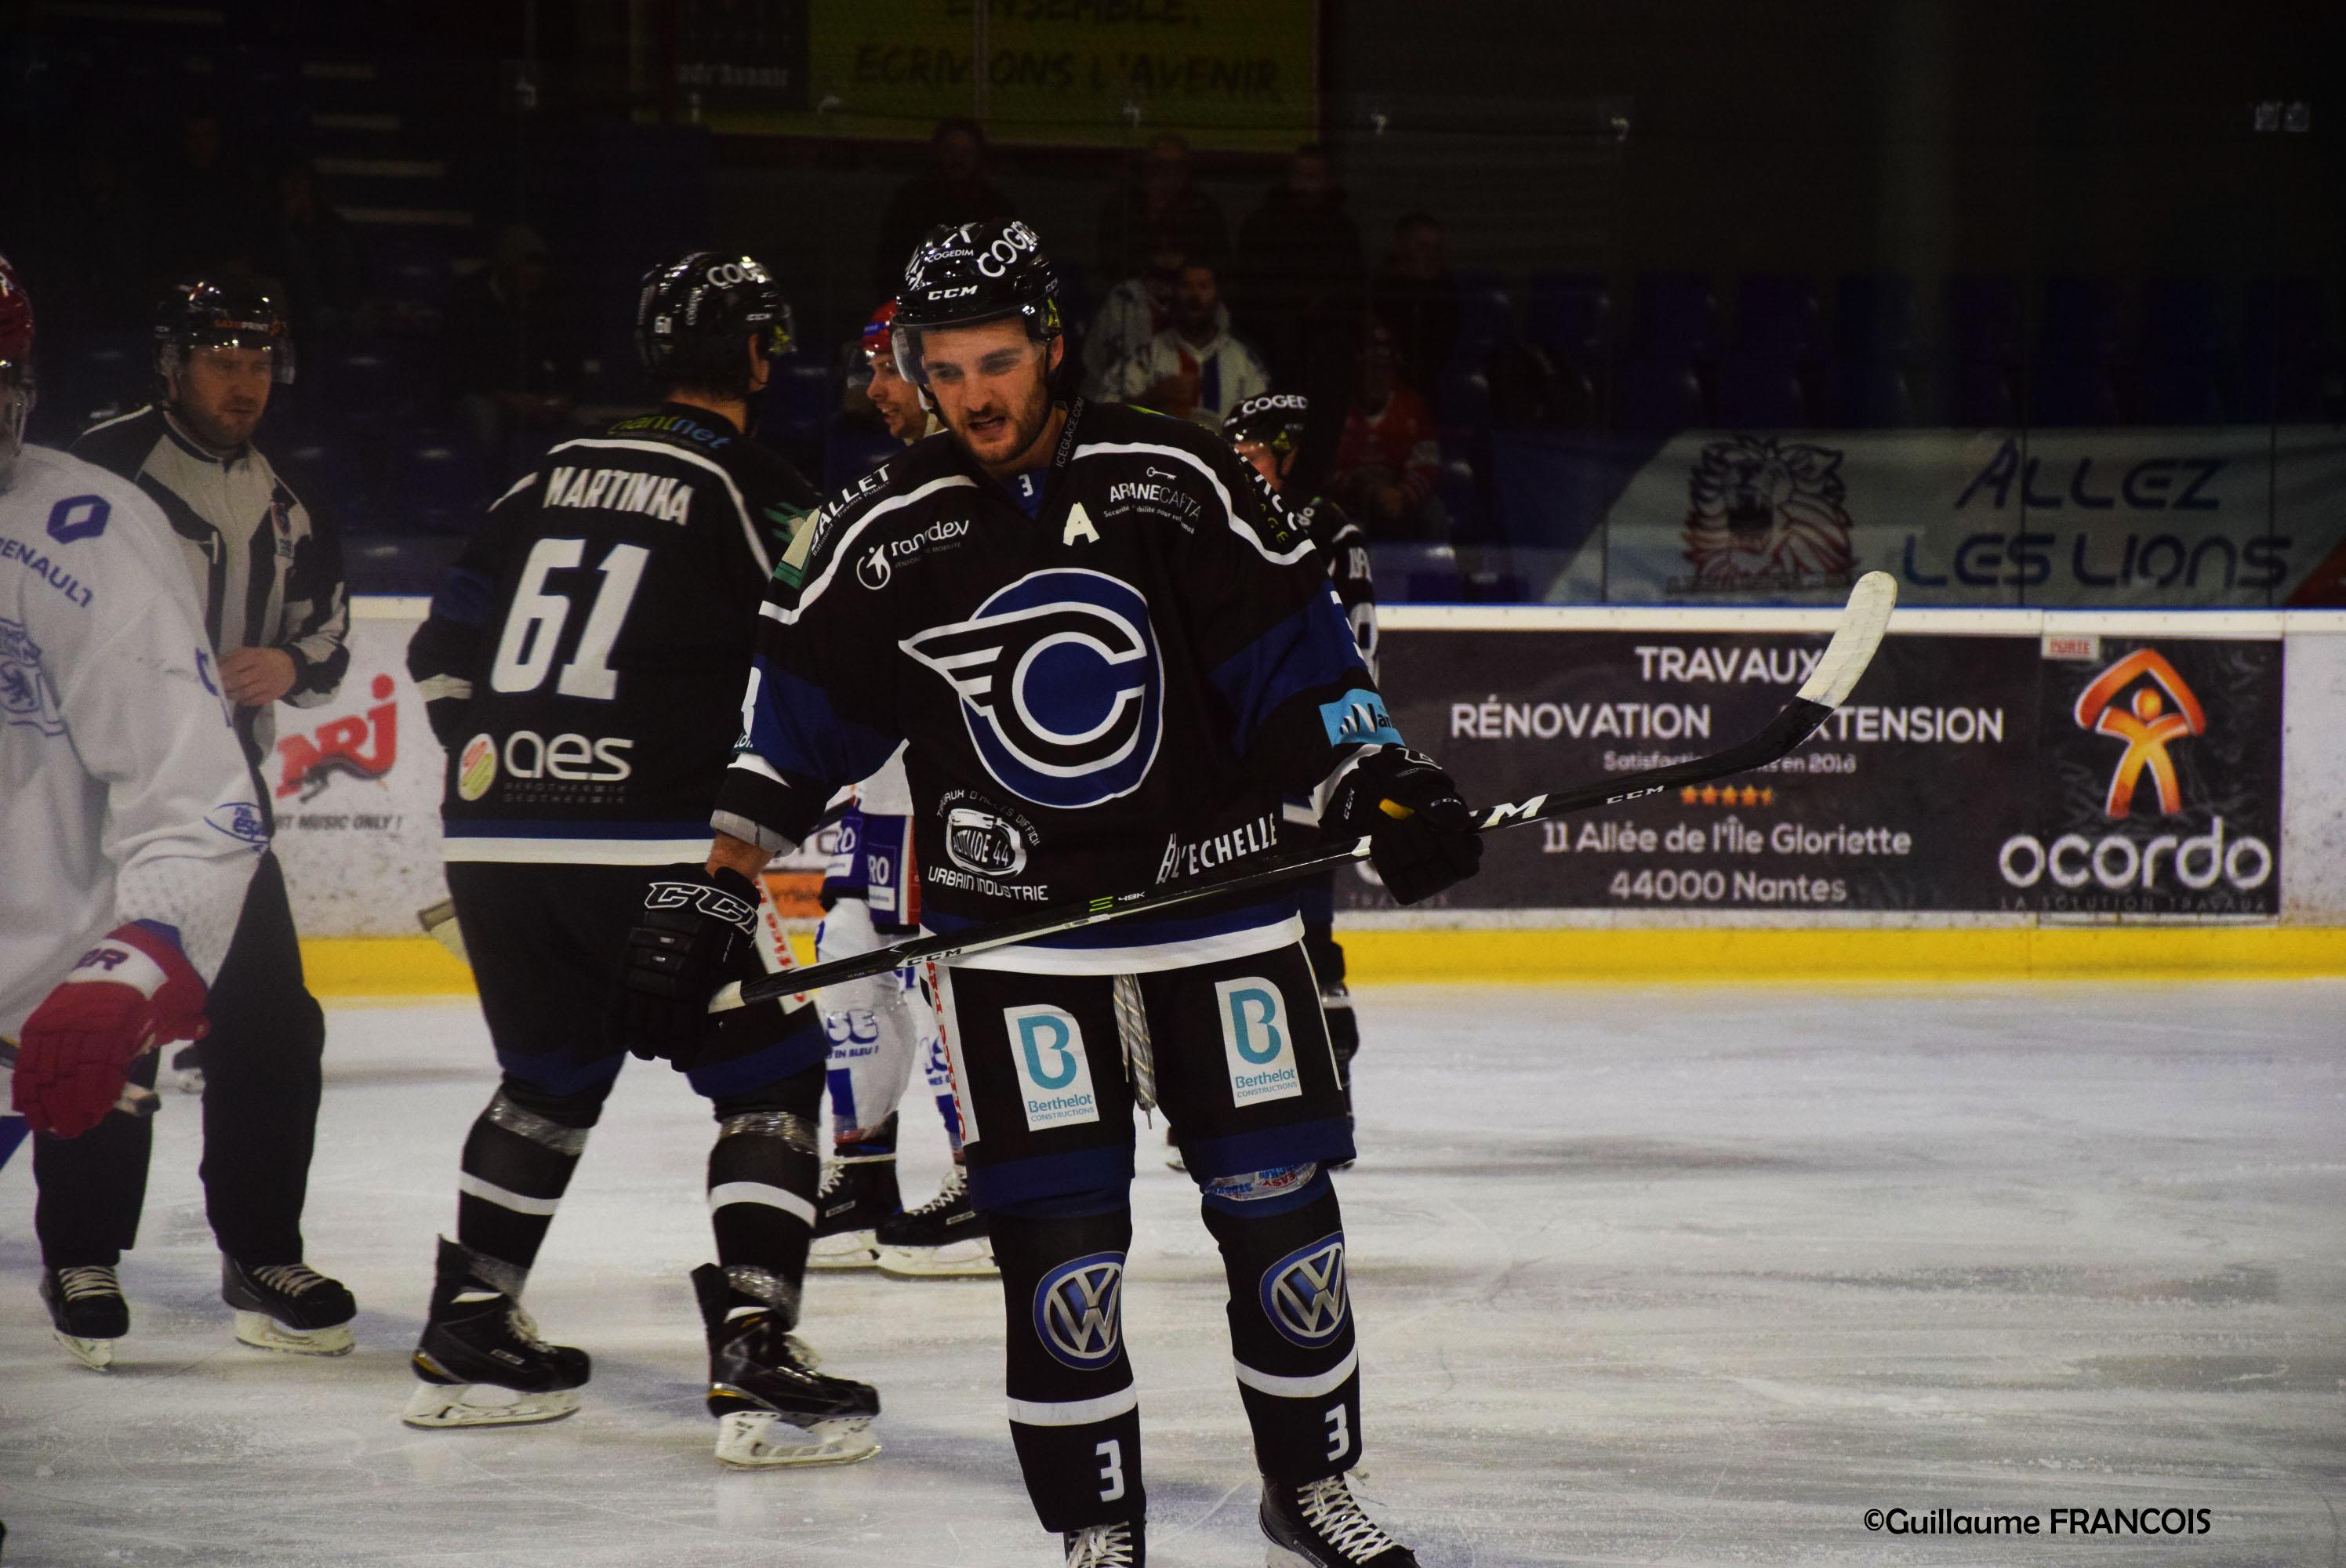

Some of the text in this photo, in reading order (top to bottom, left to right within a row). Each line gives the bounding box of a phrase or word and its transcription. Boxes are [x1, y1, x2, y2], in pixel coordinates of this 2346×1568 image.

[928, 248, 975, 263] COGEDIM
[927, 284, 979, 301] CCM
[1955, 437, 2229, 510] ALLEZ
[543, 466, 696, 526] MARTINKA
[1062, 501, 1101, 546] A
[1902, 533, 2055, 588] LES
[2072, 533, 2294, 590] LIONS
[488, 537, 652, 701] 61
[1634, 645, 1825, 685] TRAVAUX
[1450, 693, 1712, 740] RÉNOVATION
[1788, 706, 2006, 744] XTENSION
[503, 730, 634, 782] aes
[1606, 784, 1665, 805] CCM
[993, 840, 1010, 867] 44
[1542, 821, 1569, 854] 11
[1575, 820, 1658, 854] Allée
[1664, 822, 1706, 854] de
[1770, 822, 1912, 855] Gloriette
[1999, 815, 2273, 890] ocordo
[928, 865, 1050, 902] URBAIN INDUSTRIE
[1608, 869, 1848, 903] 44000 Nantes
[906, 947, 962, 967] CCM
[1229, 980, 1282, 1065] B
[1017, 1014, 1077, 1091] B
[1234, 1069, 1296, 1090] Berthelot
[1237, 1080, 1298, 1098] CONSTRUCTIONS
[1028, 1093, 1093, 1113] Berthelot
[1030, 1106, 1095, 1123] CONSTRUCTIONS
[1324, 1403, 1350, 1462] 3
[1095, 1439, 1125, 1504] 3
